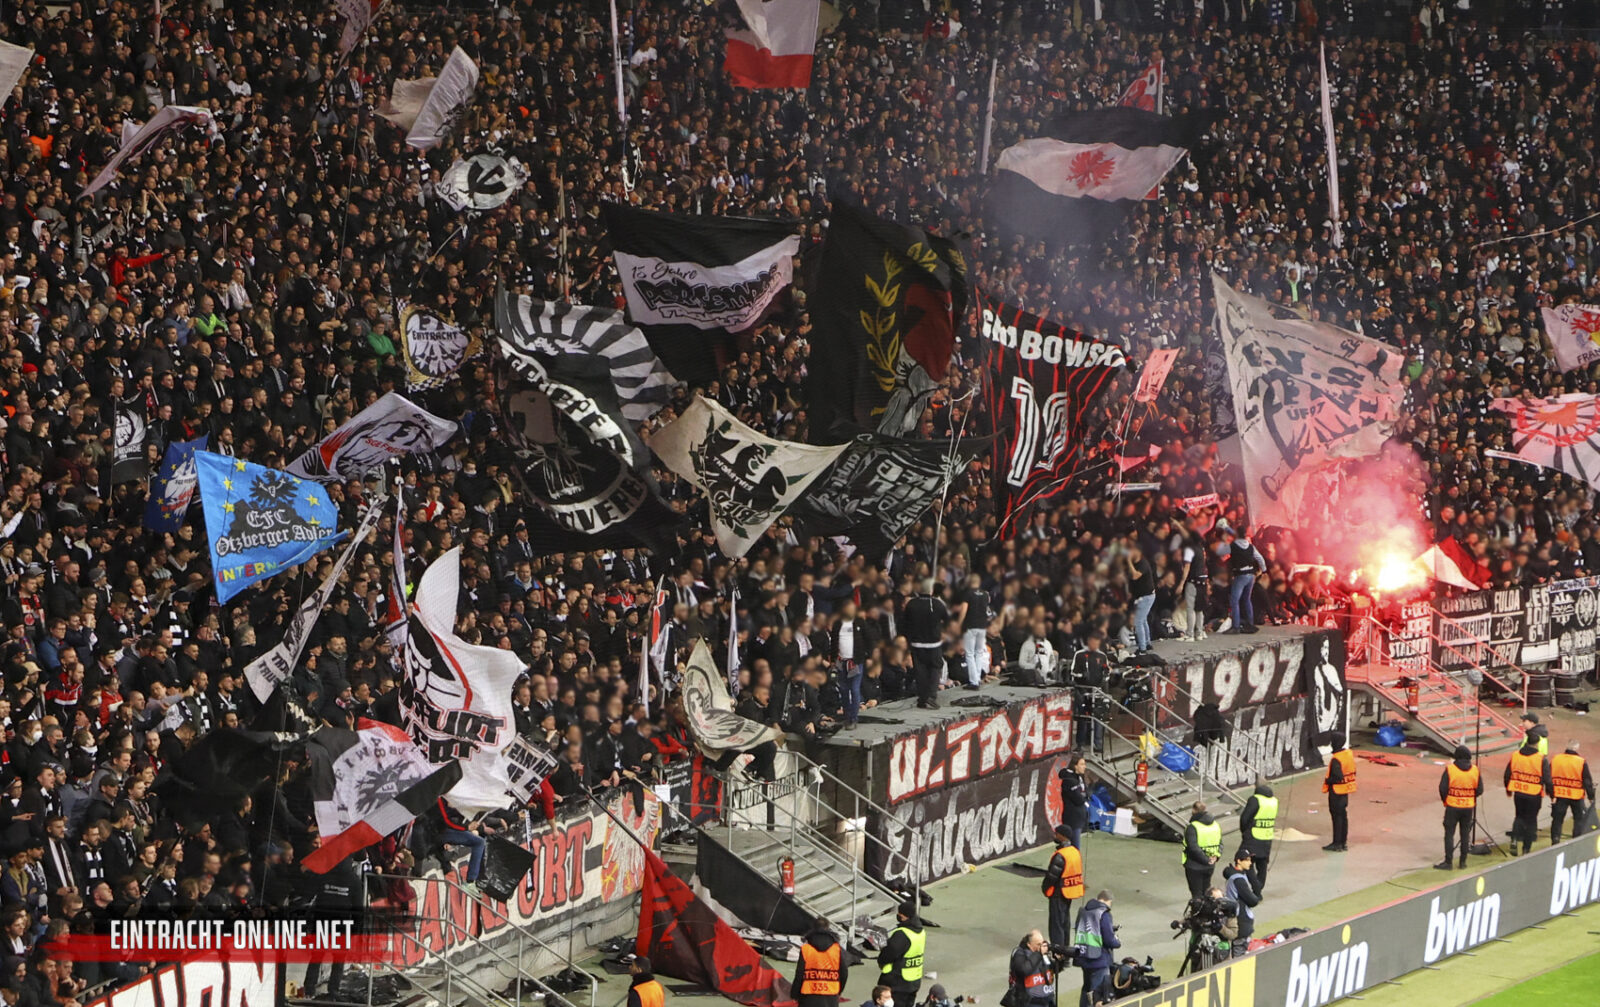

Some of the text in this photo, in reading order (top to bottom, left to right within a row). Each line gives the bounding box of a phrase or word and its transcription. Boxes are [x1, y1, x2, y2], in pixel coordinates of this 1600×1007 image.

[412, 331, 458, 341] EINTRACHT
[246, 508, 292, 530] EFC
[1443, 617, 1490, 642] FRANKFURT
[1186, 640, 1306, 718] 1997
[888, 692, 1073, 804] ULTRAS
[884, 769, 1040, 885] Eintracht
[1550, 836, 1600, 917] bwi
[1424, 876, 1500, 964] bwin
[803, 970, 840, 981] TEWARD
[1286, 924, 1369, 1007] bwin
